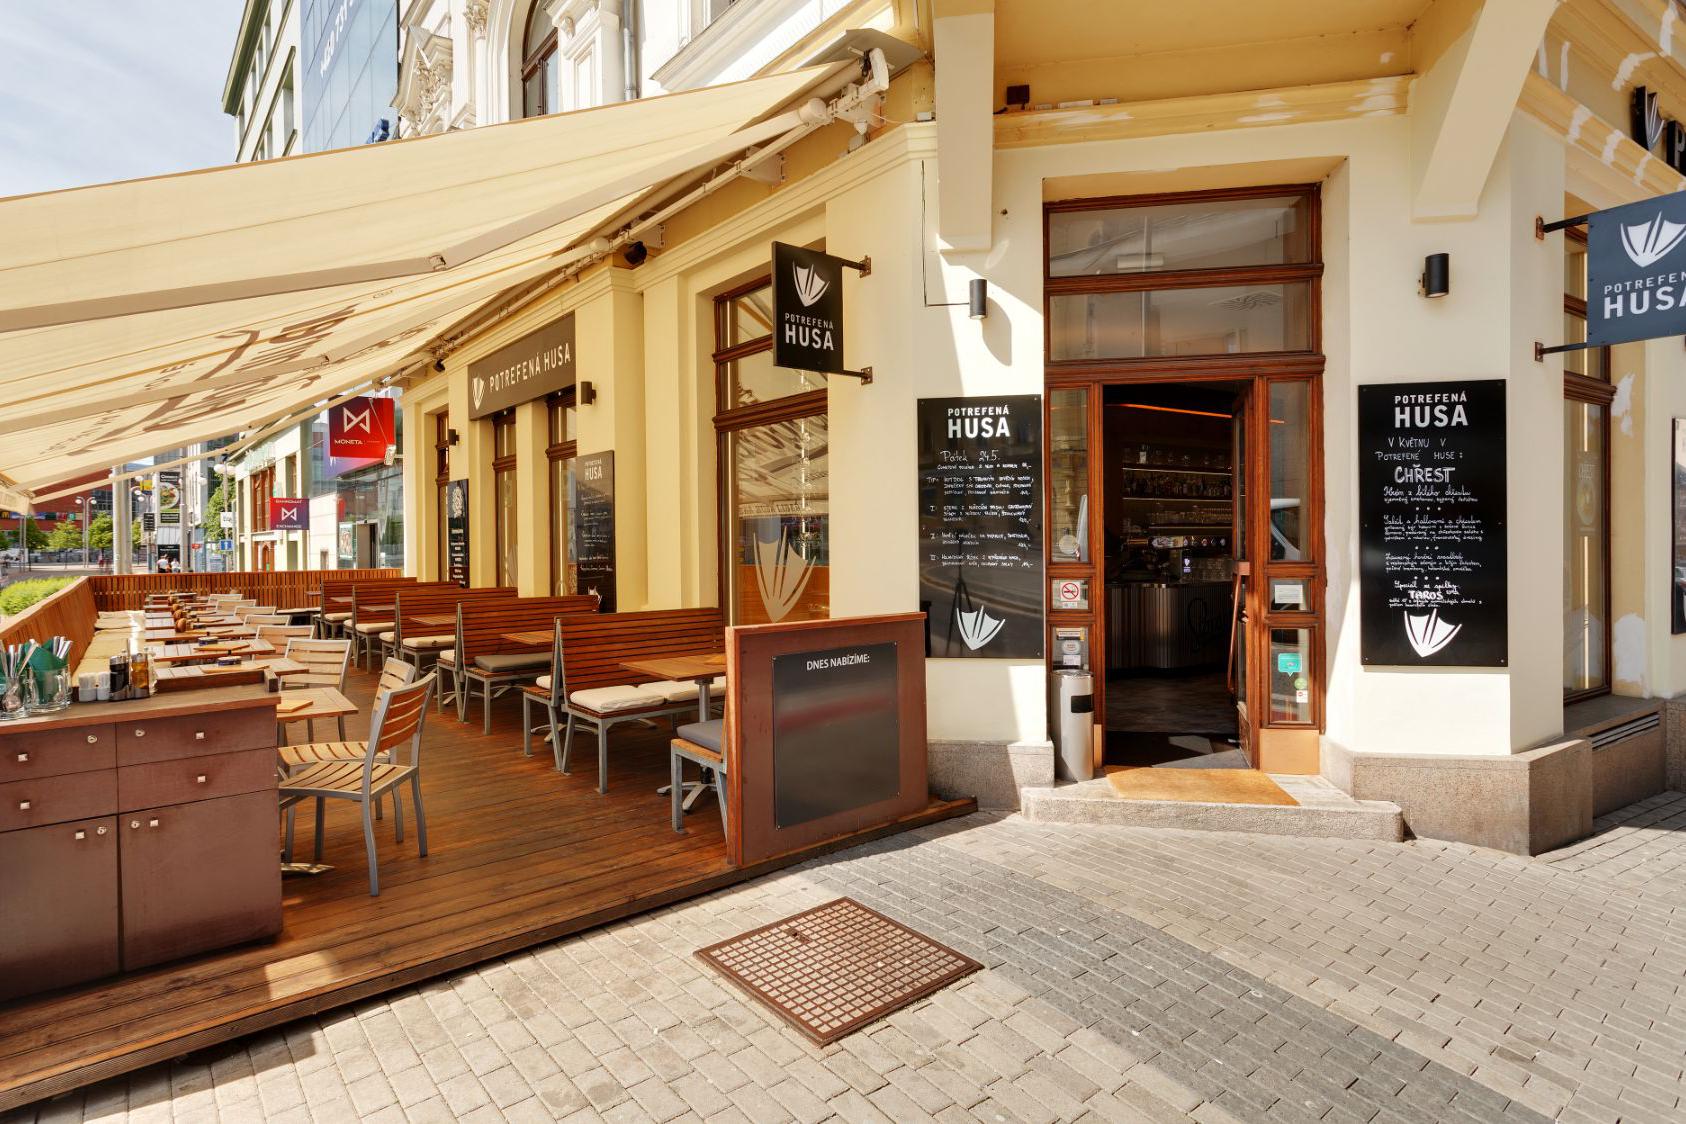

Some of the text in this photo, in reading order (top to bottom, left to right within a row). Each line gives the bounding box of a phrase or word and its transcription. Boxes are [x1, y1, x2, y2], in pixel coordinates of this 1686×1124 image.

[785, 323, 834, 351] HUSA
[489, 342, 571, 393] POTREFENÁ HUSA
[1394, 390, 1468, 405] POTREFENÁ
[947, 405, 1010, 417] POTREFENÁ
[1394, 404, 1469, 428] HUSA
[947, 417, 1011, 439] HUSA
[1388, 436, 1395, 448] V
[1440, 437, 1447, 448] V
[584, 465, 603, 481] HUSA
[1394, 464, 1456, 483] CHŘEST
[806, 653, 870, 671] DNES NABÍZÍME:
